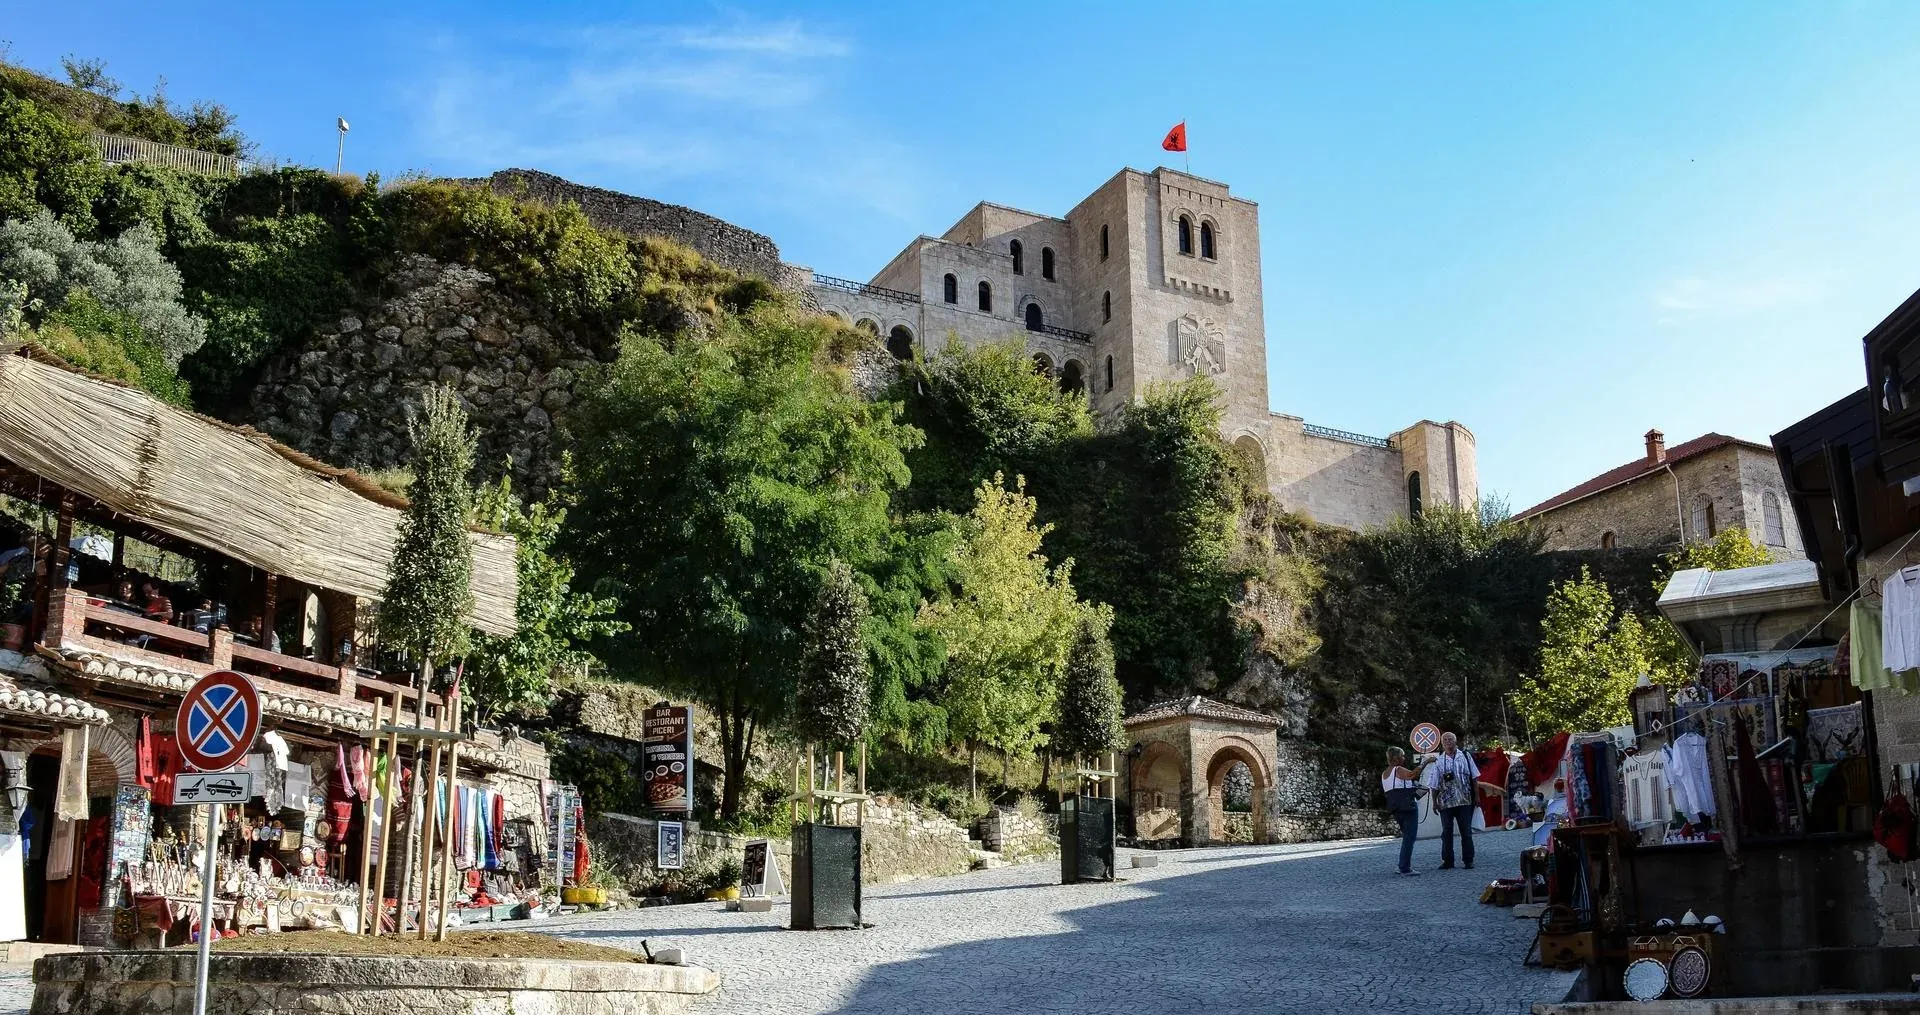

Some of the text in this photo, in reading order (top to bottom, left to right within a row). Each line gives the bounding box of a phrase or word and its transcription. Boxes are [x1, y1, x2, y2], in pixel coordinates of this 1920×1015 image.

[656, 709, 671, 717] BAR
[645, 717, 685, 727] RESTORANT
[652, 726, 675, 735] PICERI
[499, 738, 522, 758] BAR
